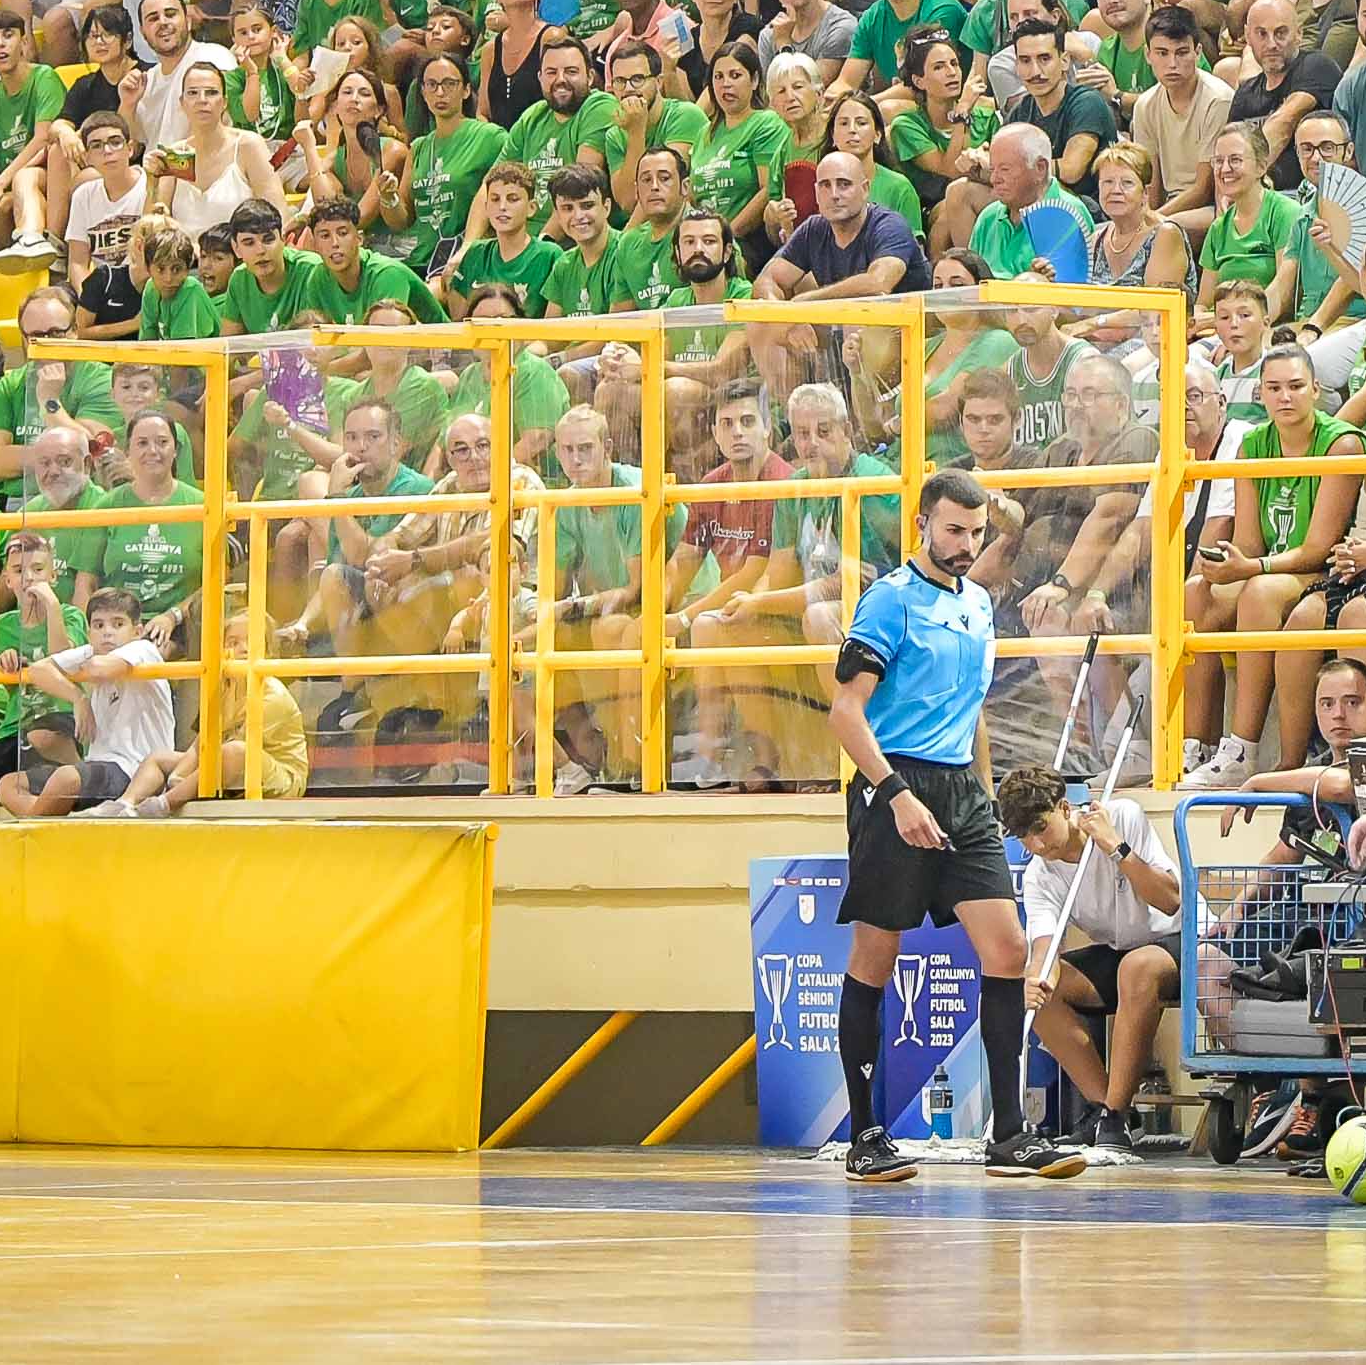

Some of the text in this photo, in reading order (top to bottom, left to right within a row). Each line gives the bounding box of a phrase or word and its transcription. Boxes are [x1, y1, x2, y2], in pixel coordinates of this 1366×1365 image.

[124, 542, 182, 555] CATALUNYA
[797, 954, 823, 968] COPA
[929, 954, 952, 967] COPA
[797, 972, 844, 987] CATALUN
[929, 968, 976, 981] CATALUNYA
[929, 999, 967, 1013] FUTBOL
[799, 1012, 840, 1029] FUTBO
[929, 1016, 956, 1030] SALA
[800, 1034, 833, 1052] SALA
[929, 1033, 954, 1047] 2023
